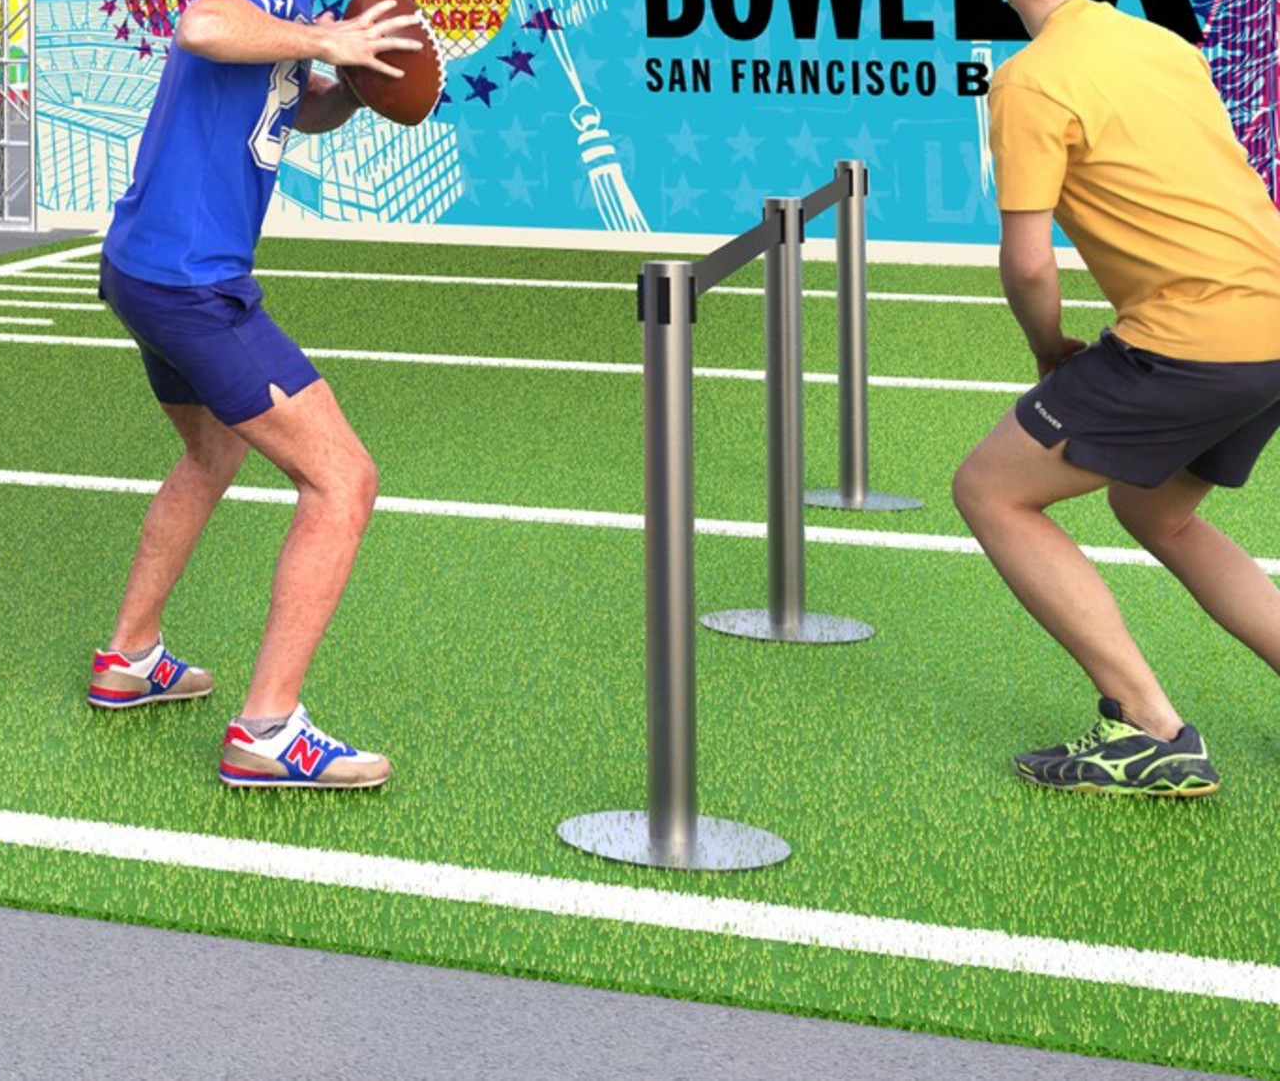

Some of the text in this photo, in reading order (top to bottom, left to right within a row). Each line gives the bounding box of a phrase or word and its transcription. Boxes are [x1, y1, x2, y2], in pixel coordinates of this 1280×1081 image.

[431, 8, 503, 31] AREA
[645, 57, 712, 94] SAN
[730, 59, 937, 97] FRANCISCO
[152, 658, 176, 688] N
[286, 736, 325, 776] N
